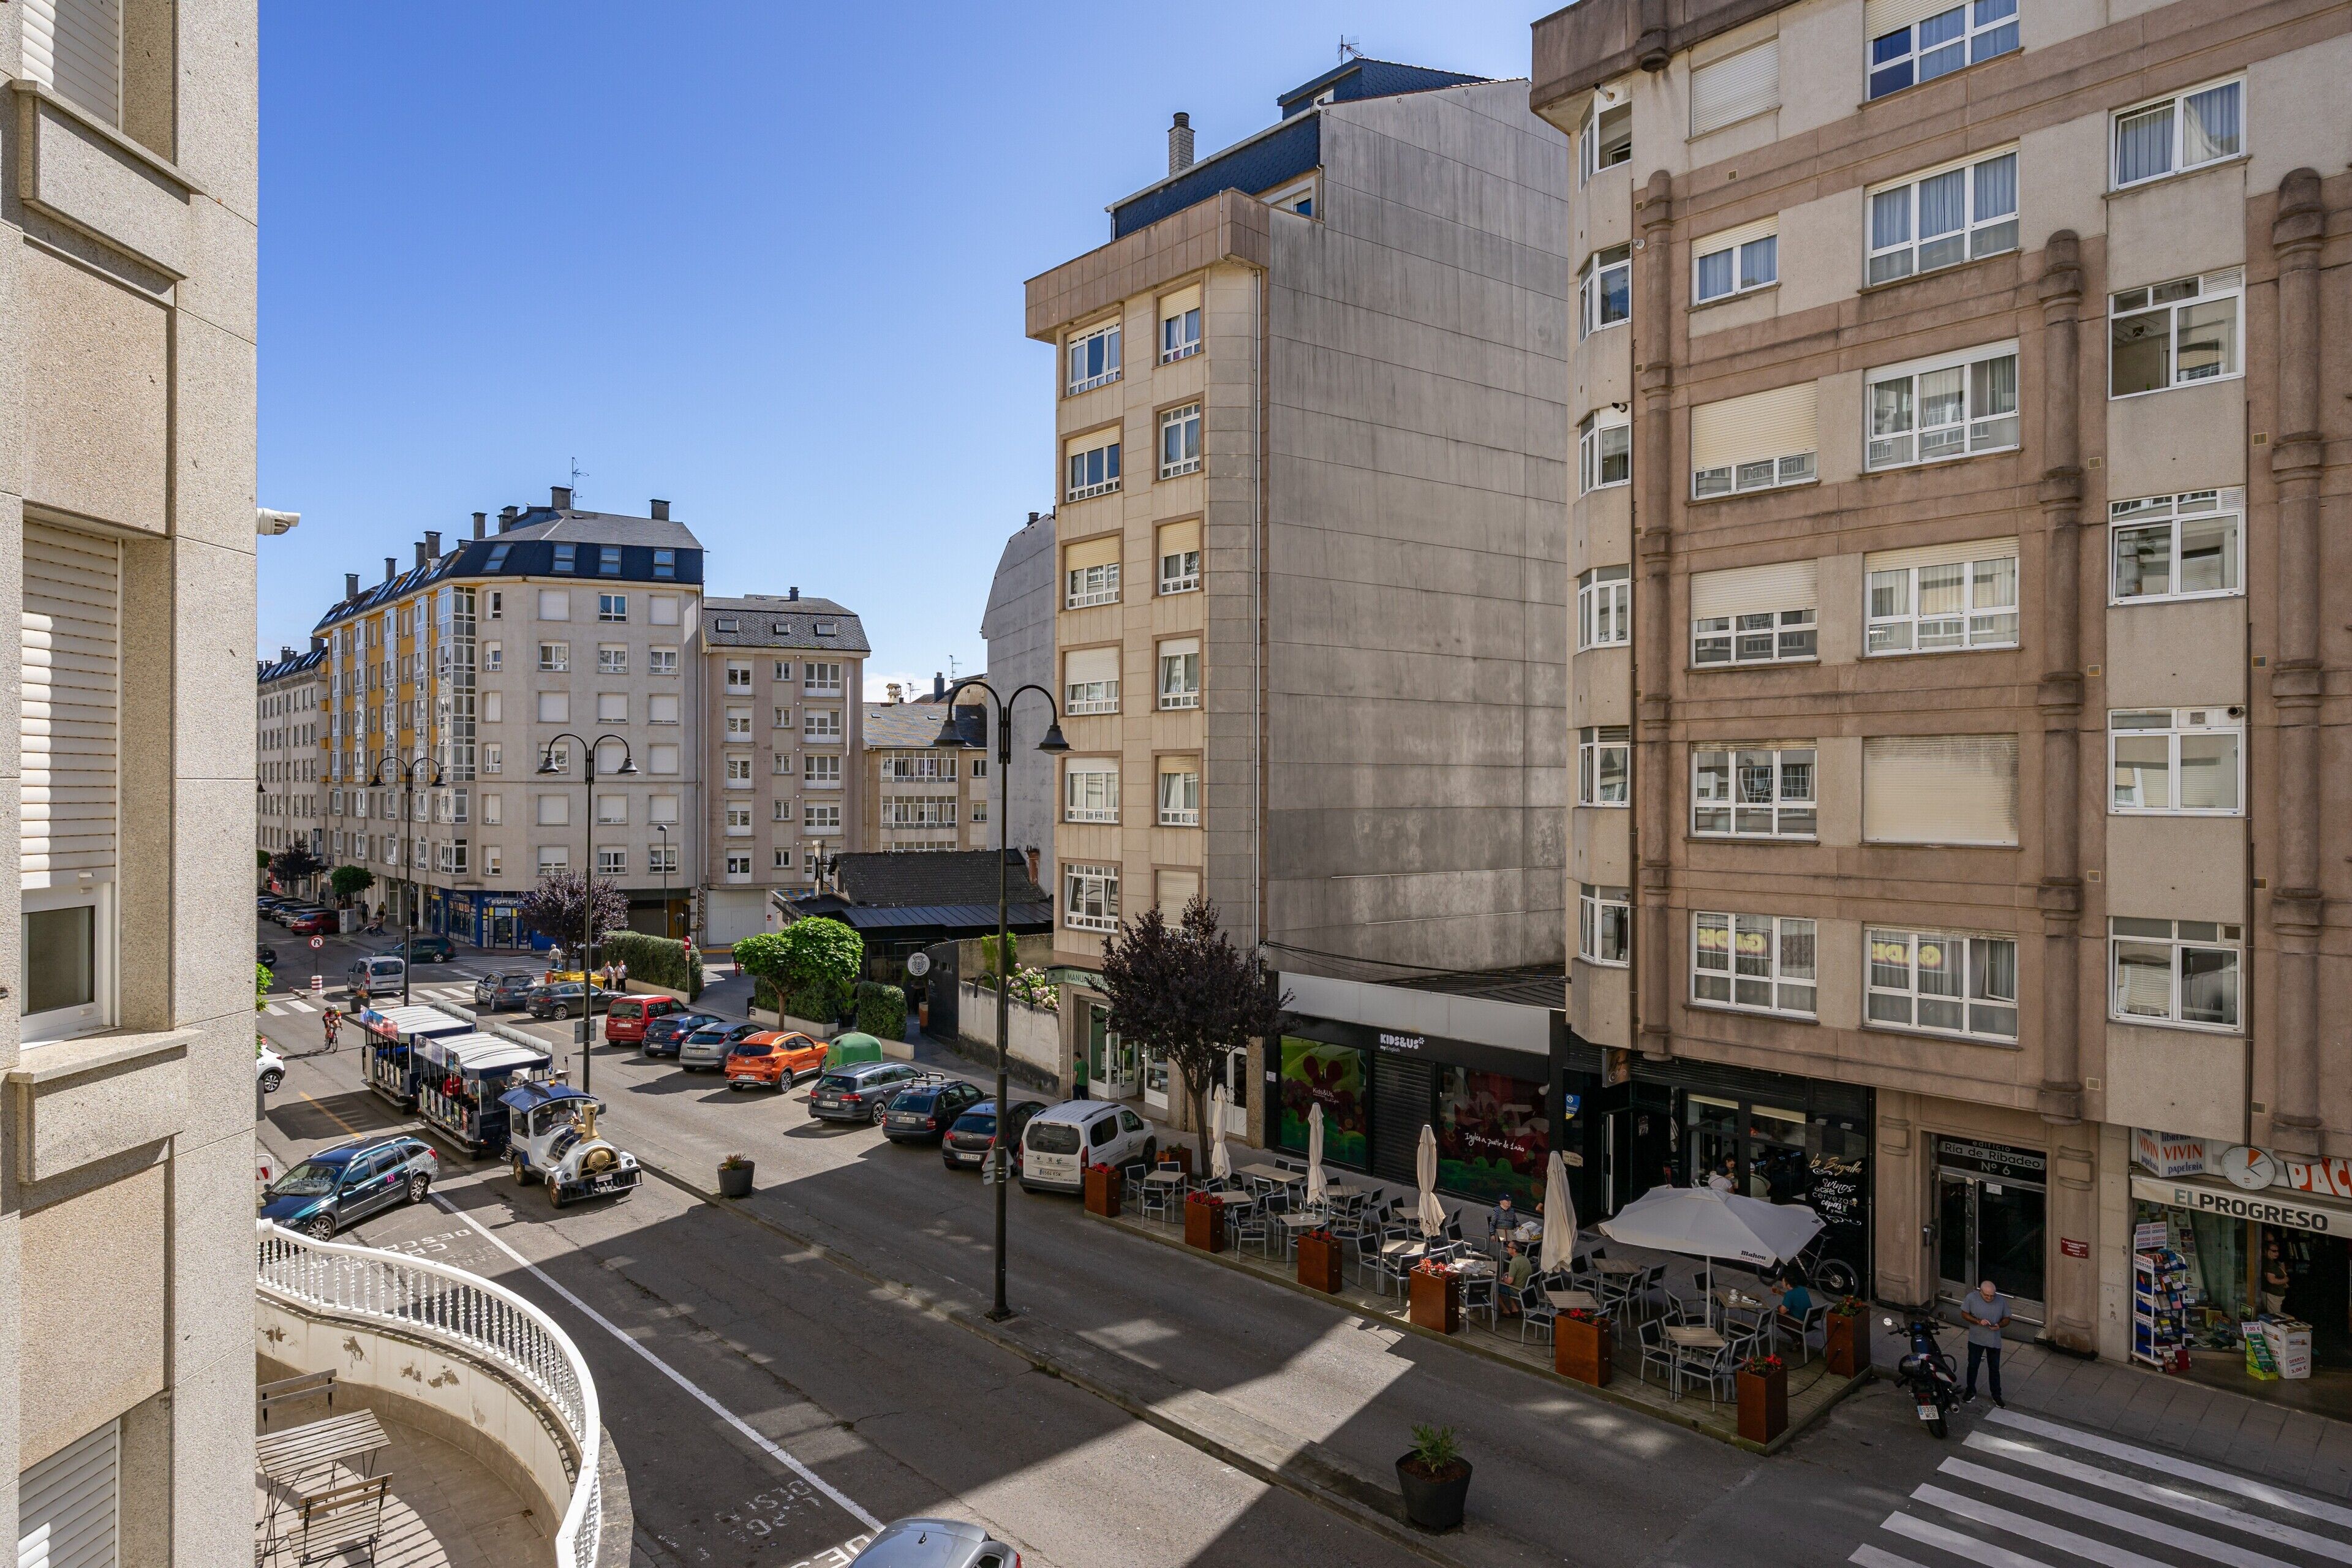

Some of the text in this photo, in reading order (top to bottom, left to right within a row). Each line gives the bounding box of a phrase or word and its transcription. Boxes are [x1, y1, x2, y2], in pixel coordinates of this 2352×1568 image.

[1945, 1143, 2040, 1168] Ría de Ribadeo
[2163, 1143, 2203, 1161] VIVIN
[2002, 1166, 2010, 1175] 6
[386, 1173, 395, 1183] 18
[1812, 1192, 1853, 1205] cervezas
[1821, 1199, 1842, 1211] copas
[1741, 1250, 1766, 1261] Mahou
[2135, 1255, 2152, 1264] OFERTAS
[2135, 1260, 2152, 1269] OFERTAS
